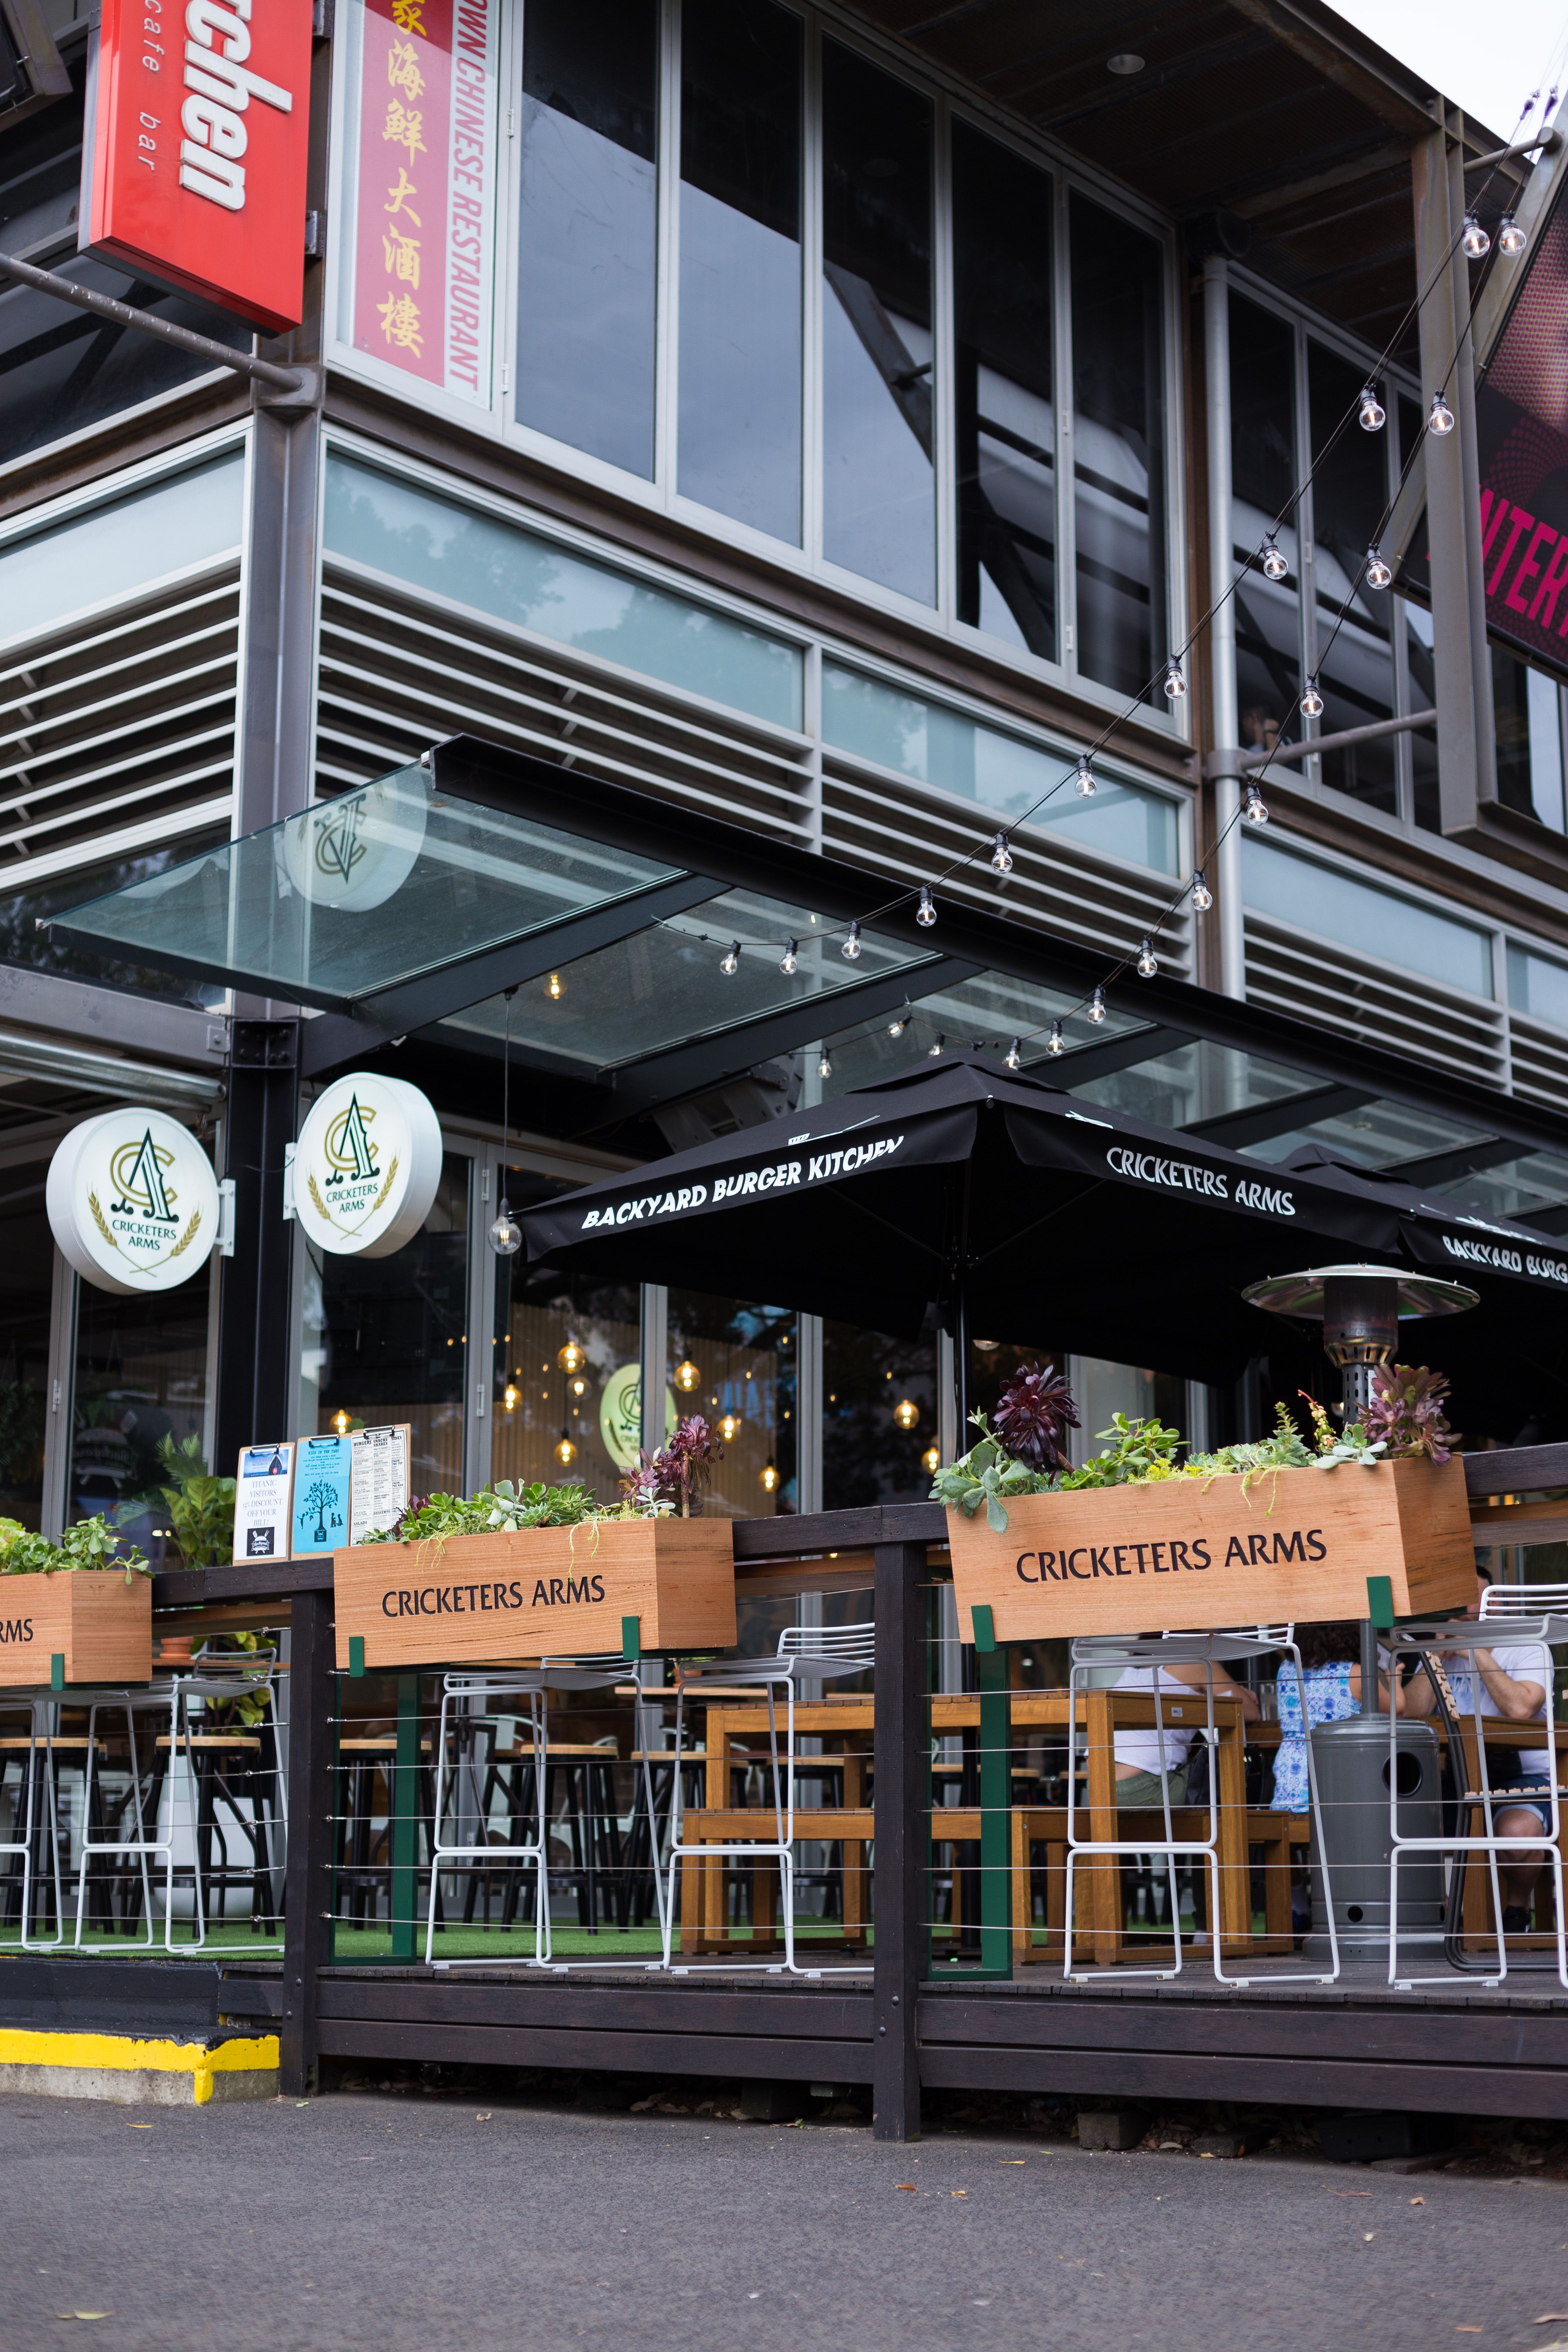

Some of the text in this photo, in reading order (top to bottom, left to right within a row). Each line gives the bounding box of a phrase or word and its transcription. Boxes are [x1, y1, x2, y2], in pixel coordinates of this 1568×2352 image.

[138, 0, 164, 171] cafe bar
[179, 0, 292, 211] chen
[453, 57, 485, 193] CHINESE
[449, 190, 482, 391] RESTAURANT
[327, 1183, 378, 1203] CRICKETERS
[582, 1135, 904, 1229] BACKYARD BURGER KITCHEN
[1106, 1147, 1295, 1216] CRICKETERS ARMS
[339, 1200, 364, 1214] ARMS
[112, 1219, 176, 1240] CRICKETERS
[128, 1236, 160, 1251] ARMS
[1442, 1235, 1522, 1273] BACKYARD
[250, 1489, 276, 1497] VISITORS
[252, 1479, 277, 1488] TITANIC
[251, 1498, 282, 1508] DISCOUNT
[259, 1508, 276, 1516] YOUR
[1016, 1529, 1327, 1583] CRICKETERS ARMS
[383, 1574, 605, 1617] CRICKETERS ARMS
